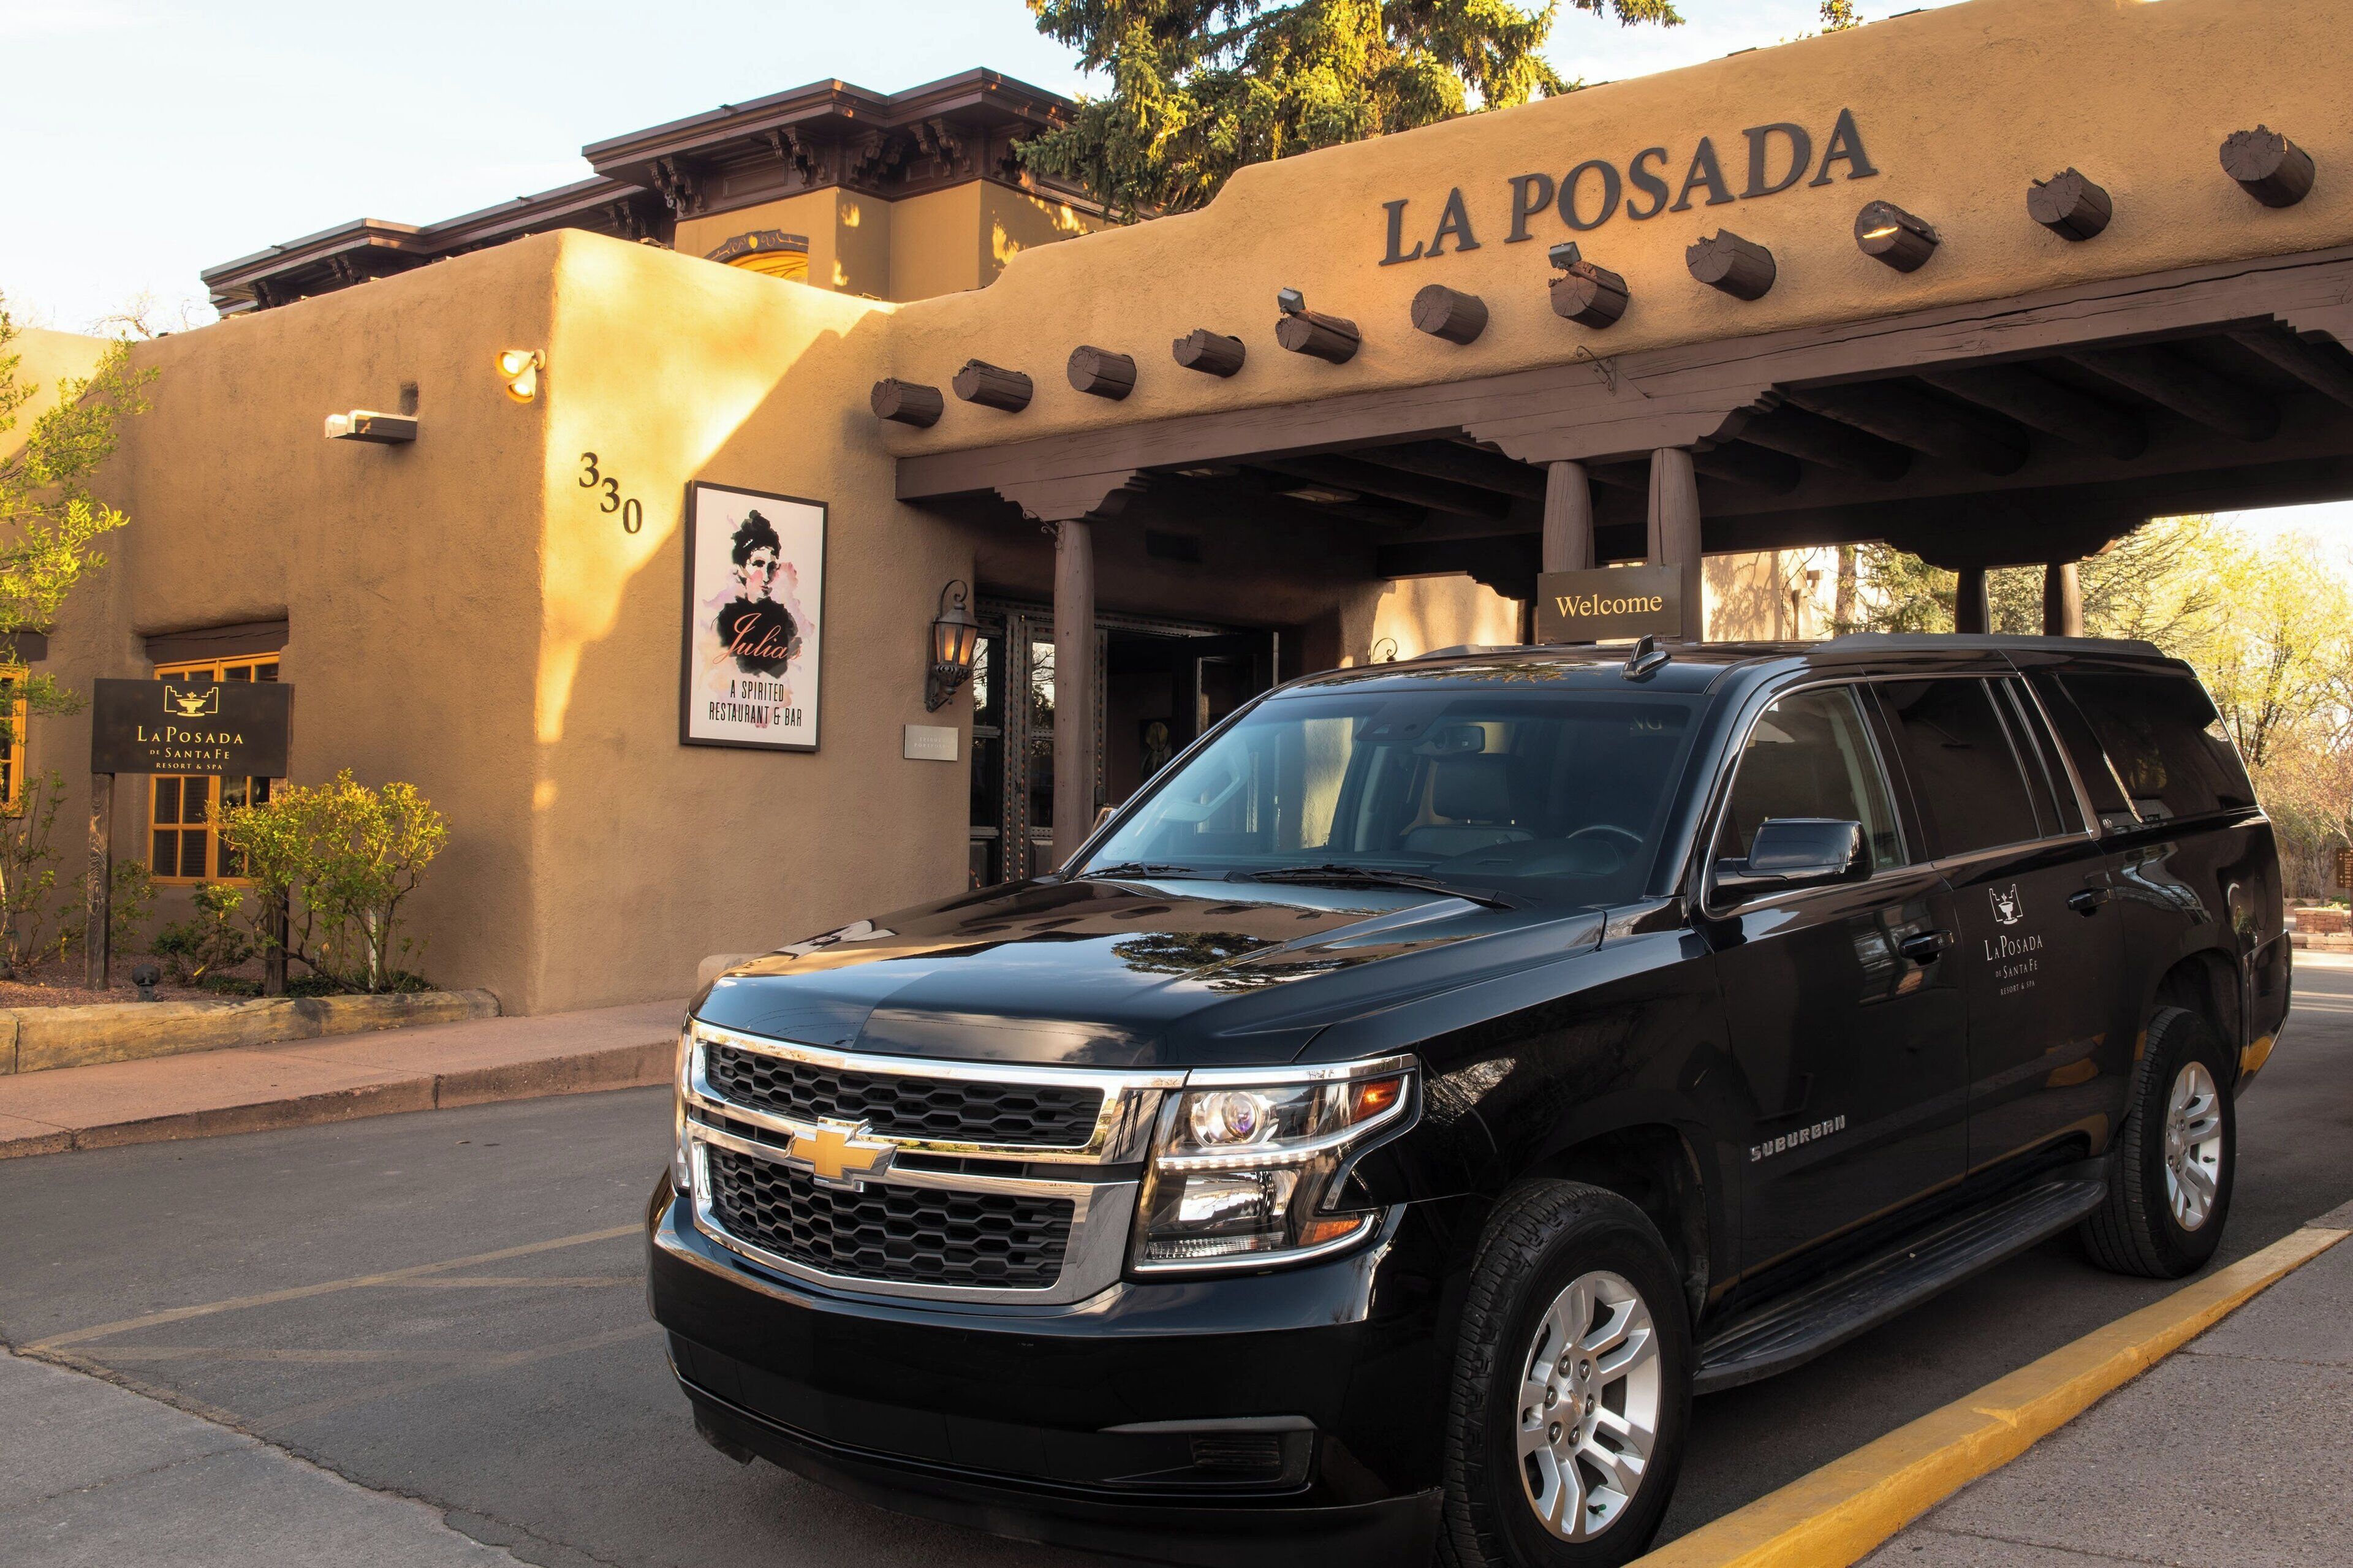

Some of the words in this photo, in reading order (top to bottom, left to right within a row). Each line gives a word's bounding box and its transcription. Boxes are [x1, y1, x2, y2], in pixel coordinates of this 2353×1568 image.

[1378, 187, 1480, 266] LA
[1503, 107, 1879, 244] POSADA
[578, 452, 643, 534] 330
[1555, 594, 1662, 618] Welcome
[730, 680, 736, 698] A
[741, 681, 784, 702] SPIRITED
[709, 701, 769, 724] RESTAURANT
[773, 706, 781, 725] &
[785, 708, 802, 727] BAR
[2000, 983, 2020, 996] RESORT
[2026, 980, 2035, 989] SPA
[1749, 1114, 1846, 1162] SUBURBAN
